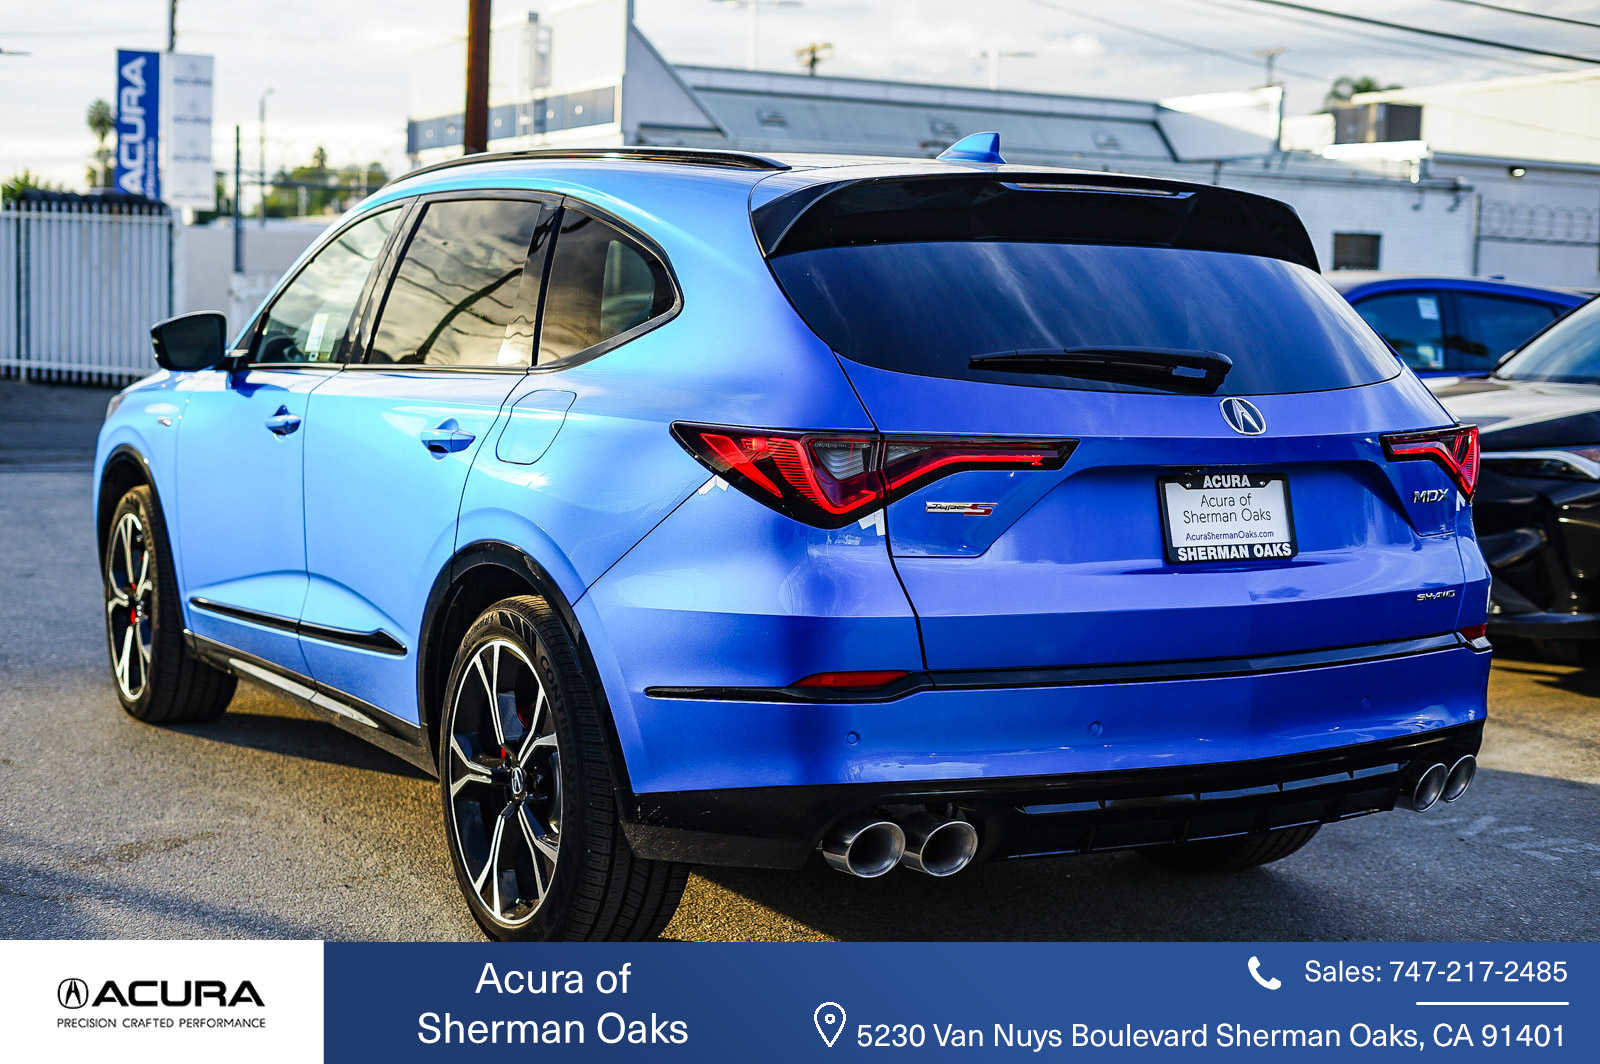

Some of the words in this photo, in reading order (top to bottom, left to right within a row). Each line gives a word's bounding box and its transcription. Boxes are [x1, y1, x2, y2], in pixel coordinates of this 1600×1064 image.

[118, 56, 147, 195] ACURA
[1203, 475, 1251, 488] ACURA
[1200, 495, 1235, 508] Acura
[1239, 493, 1252, 506] of
[1413, 488, 1449, 504] MDX
[1183, 510, 1237, 524] Sherman
[1241, 508, 1272, 522] Oaks
[1185, 530, 1274, 542] AcuraShermanOaks.com
[1178, 545, 1249, 561] SHERMAN
[1253, 543, 1292, 558] OAKS
